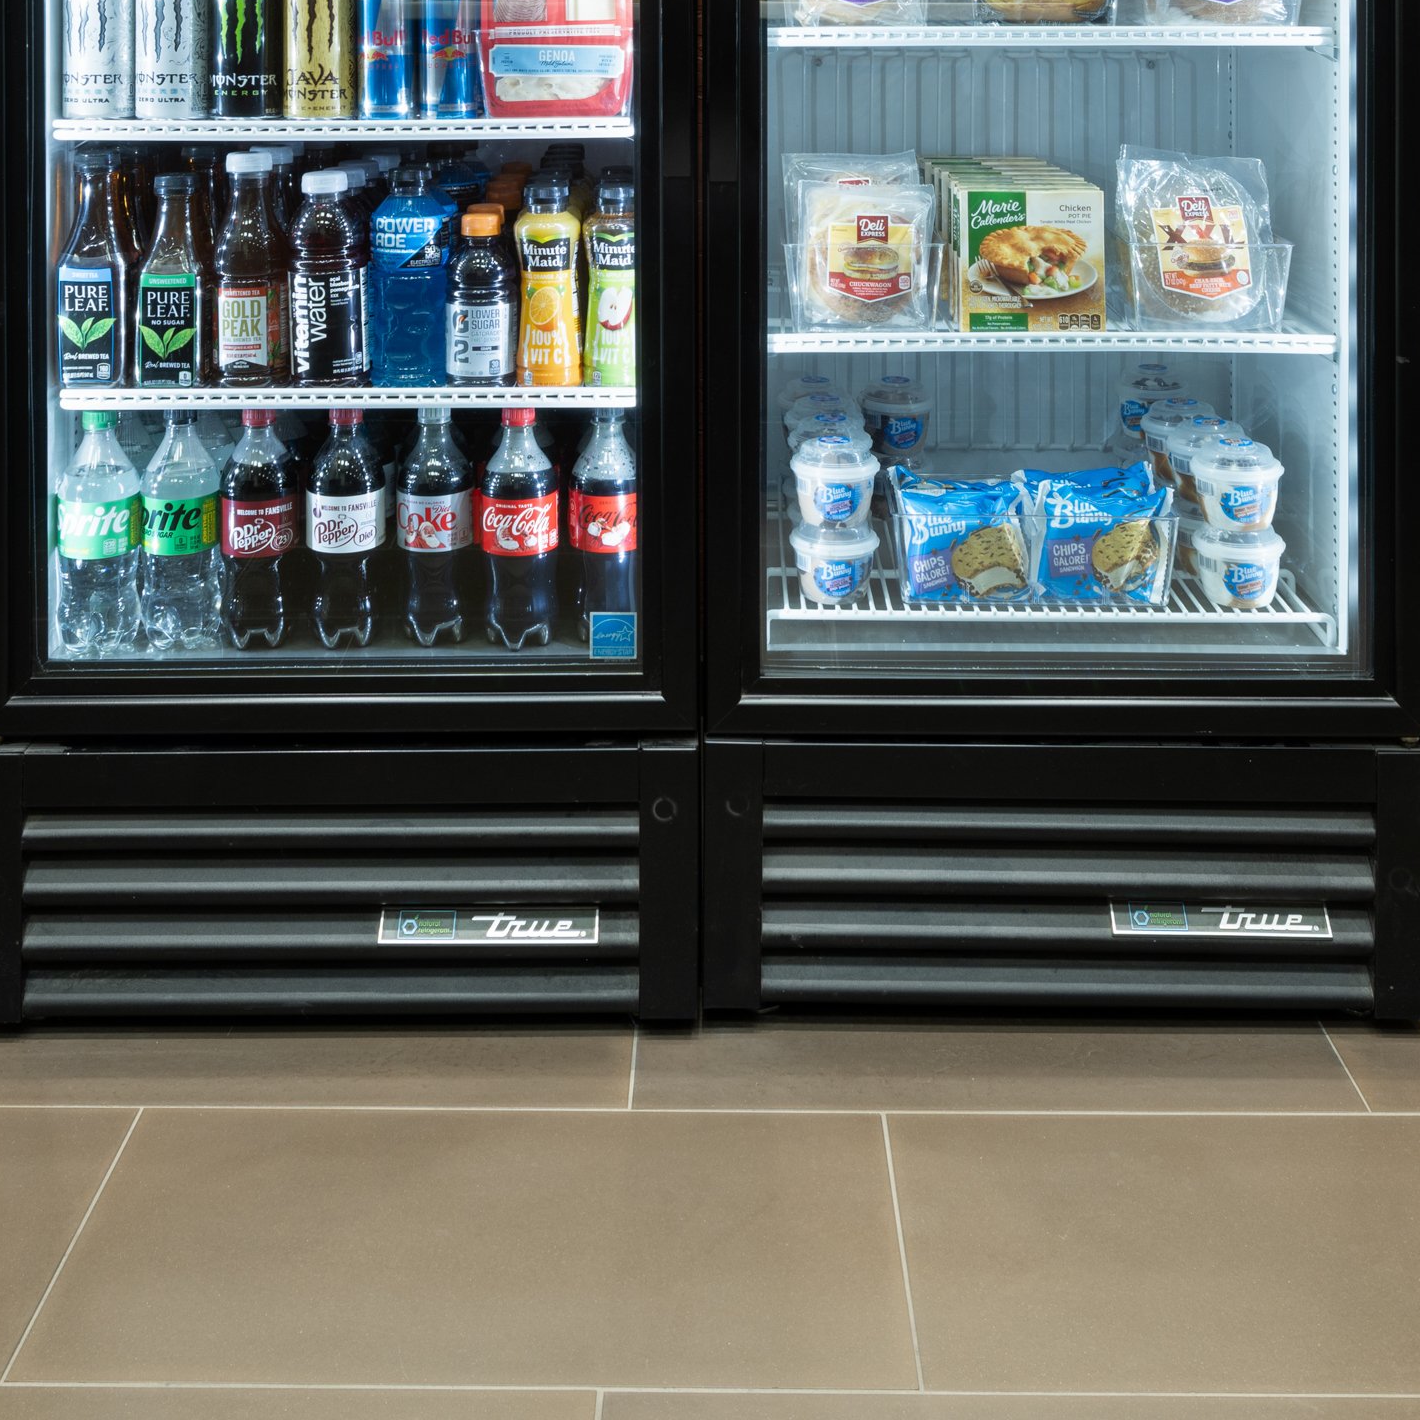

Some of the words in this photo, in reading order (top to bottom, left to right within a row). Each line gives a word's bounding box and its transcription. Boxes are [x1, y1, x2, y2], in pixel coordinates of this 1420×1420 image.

[539, 51, 576, 61] GENOA
[210, 73, 276, 87] MONSTER
[977, 200, 1021, 216] Marie
[375, 218, 434, 233] POWER
[859, 219, 885, 230] Deli
[971, 214, 1025, 229] Callender's
[375, 234, 406, 248] ADE
[523, 244, 566, 255] Minute
[529, 256, 560, 267] Maid
[147, 291, 190, 304] PURE
[222, 300, 260, 319] GOLD
[311, 278, 327, 342] water
[472, 309, 500, 319] LOWER
[222, 319, 261, 336] PEAK
[294, 276, 310, 372] vitamin
[472, 319, 500, 329] SUGAR
[398, 502, 457, 531] Coke
[232, 529, 272, 551] Pepper
[1053, 544, 1085, 557] CHIPS
[1052, 555, 1090, 567] GALORE!
